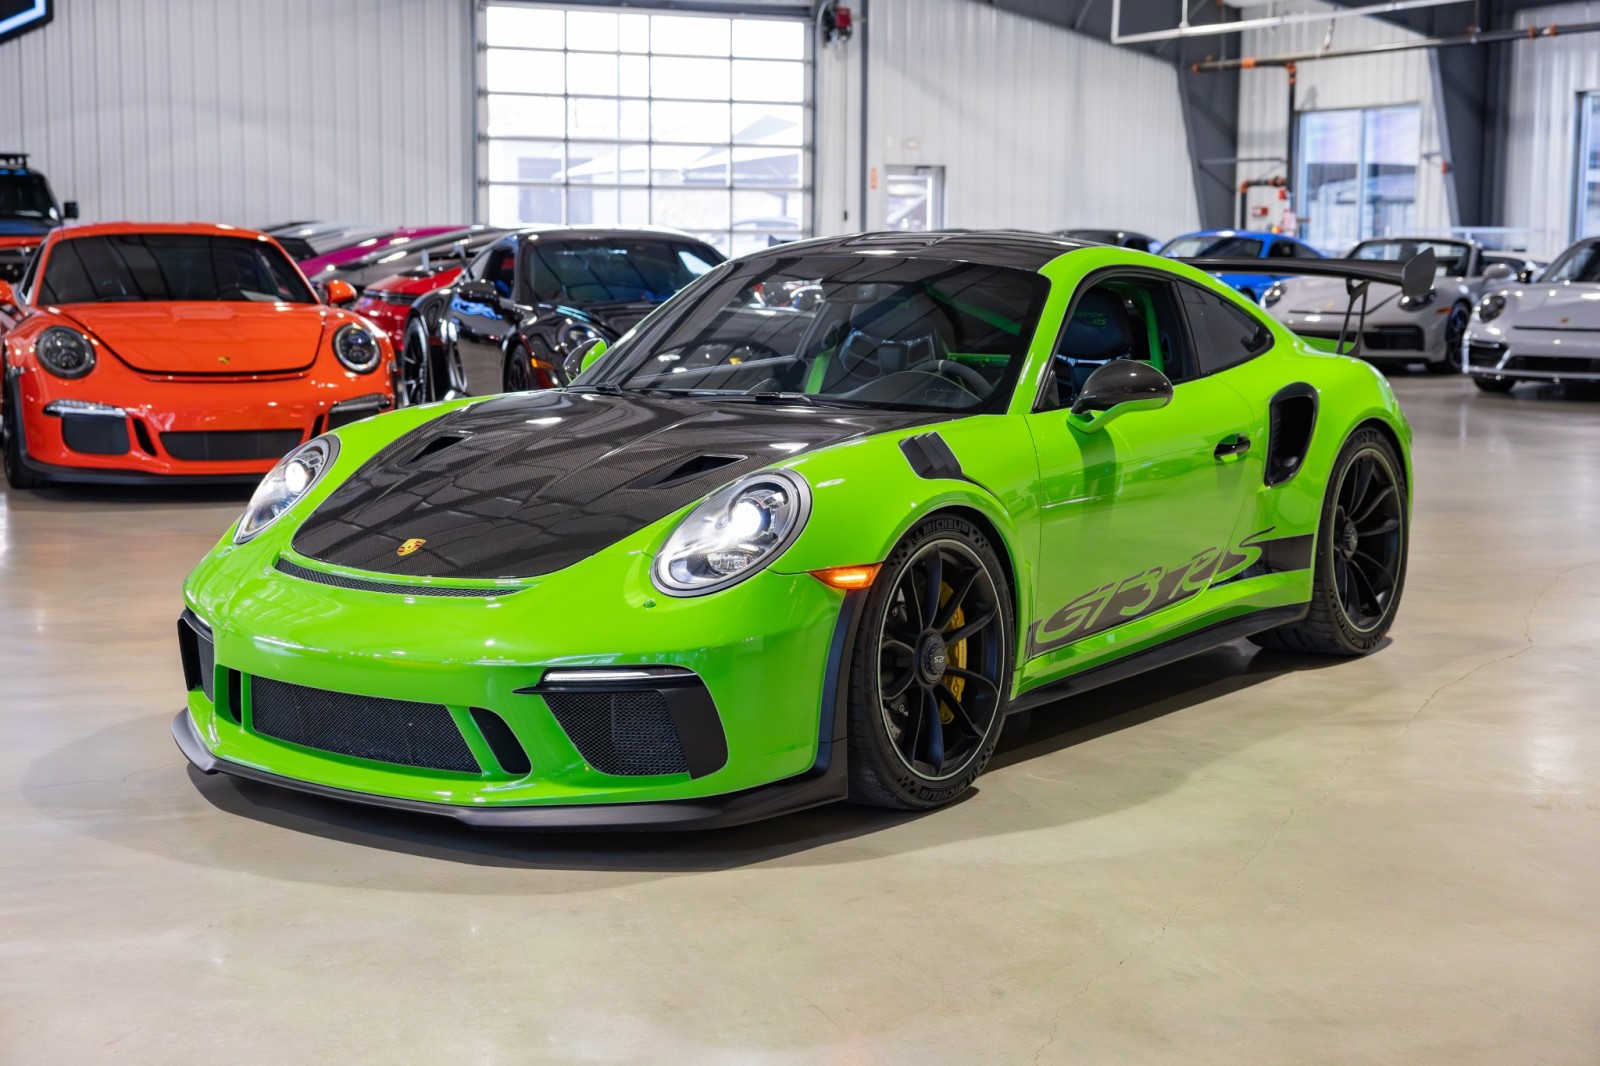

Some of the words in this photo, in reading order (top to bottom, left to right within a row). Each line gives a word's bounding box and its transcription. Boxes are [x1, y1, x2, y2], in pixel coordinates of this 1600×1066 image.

[924, 519, 969, 535] MICHELIN
[1036, 566, 1160, 643] GT3
[1169, 526, 1275, 599] RS
[919, 780, 967, 801] MICHELIN
